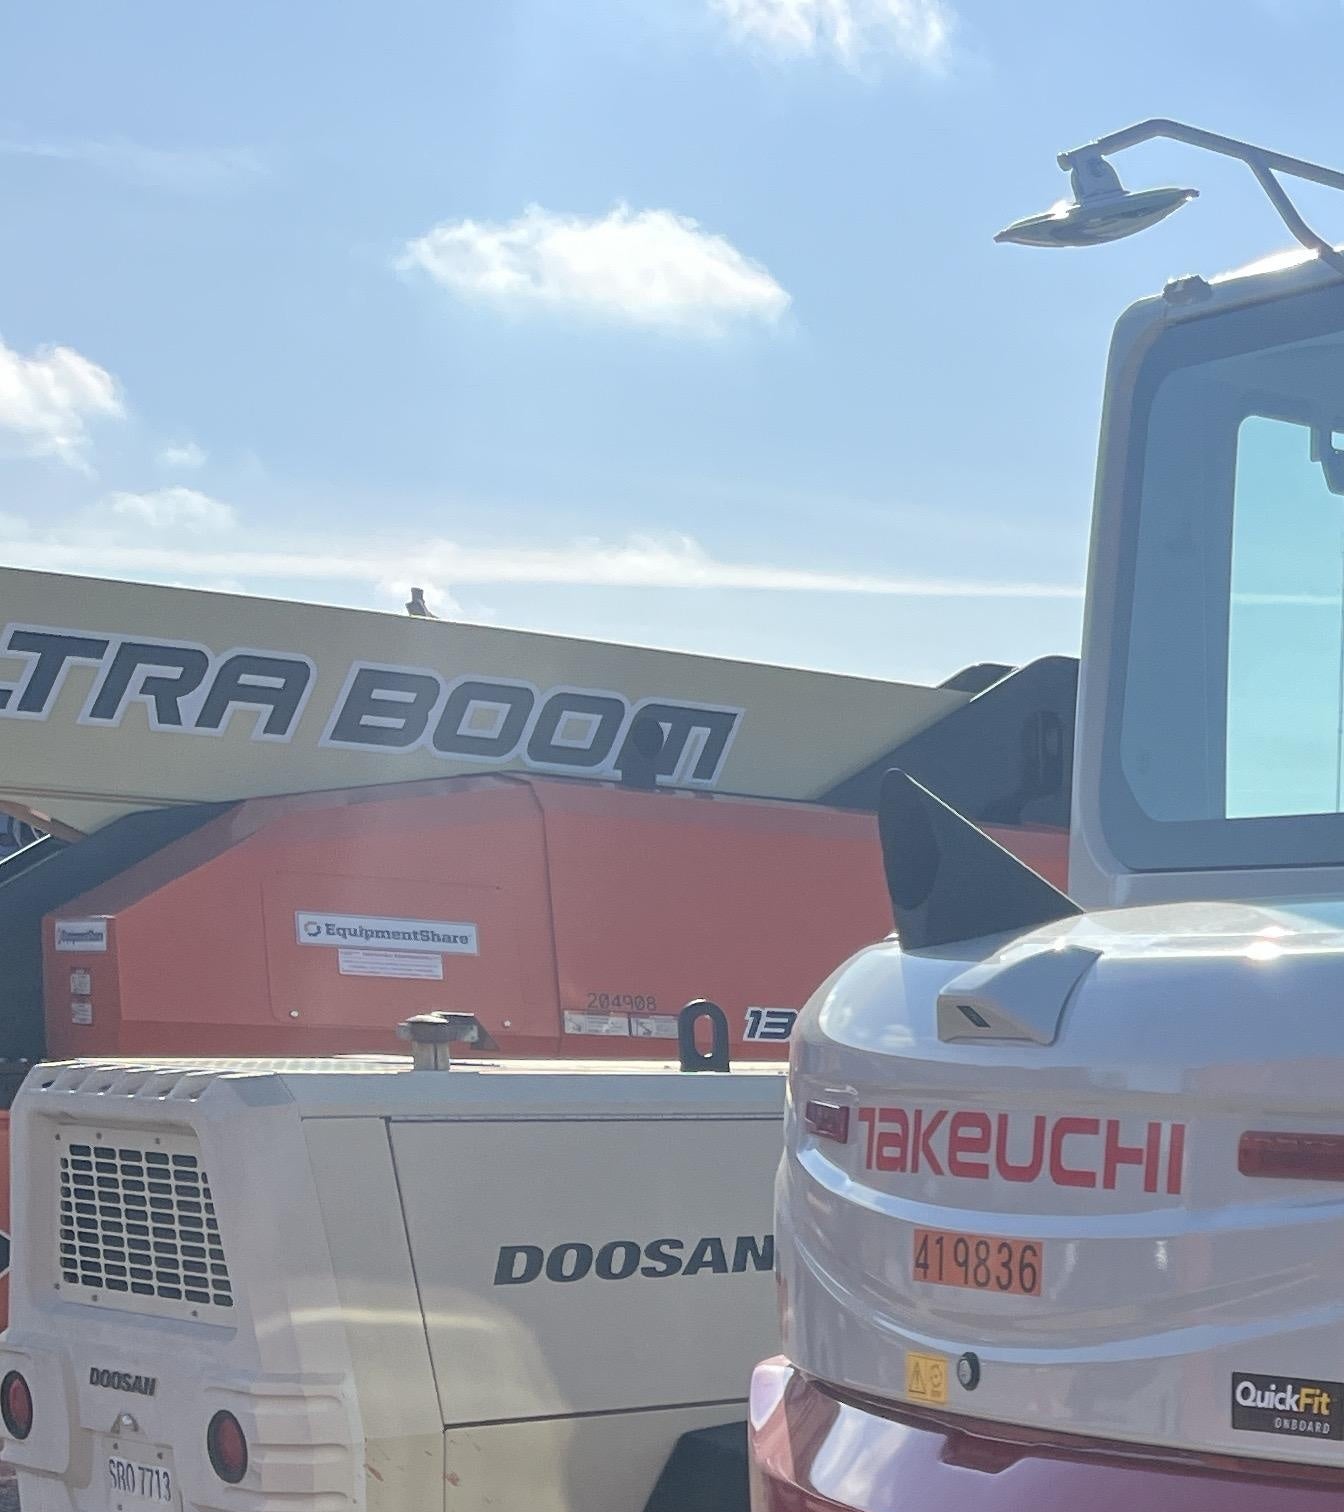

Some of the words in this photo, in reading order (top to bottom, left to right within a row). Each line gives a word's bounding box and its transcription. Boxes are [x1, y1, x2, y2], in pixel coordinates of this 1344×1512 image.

[0, 625, 316, 742] TRA
[322, 662, 744, 786] BOOM
[325, 923, 469, 945] EquipmentShare
[587, 992, 657, 1012] 204908
[493, 1234, 775, 1286] DOOSAN
[913, 1236, 1039, 1293] 419836
[89, 1367, 157, 1396] DOOSAN
[1236, 1380, 1331, 1416] QuickFit
[1274, 1417, 1331, 1434] ONBOARD
[138, 1466, 171, 1502] 7713
